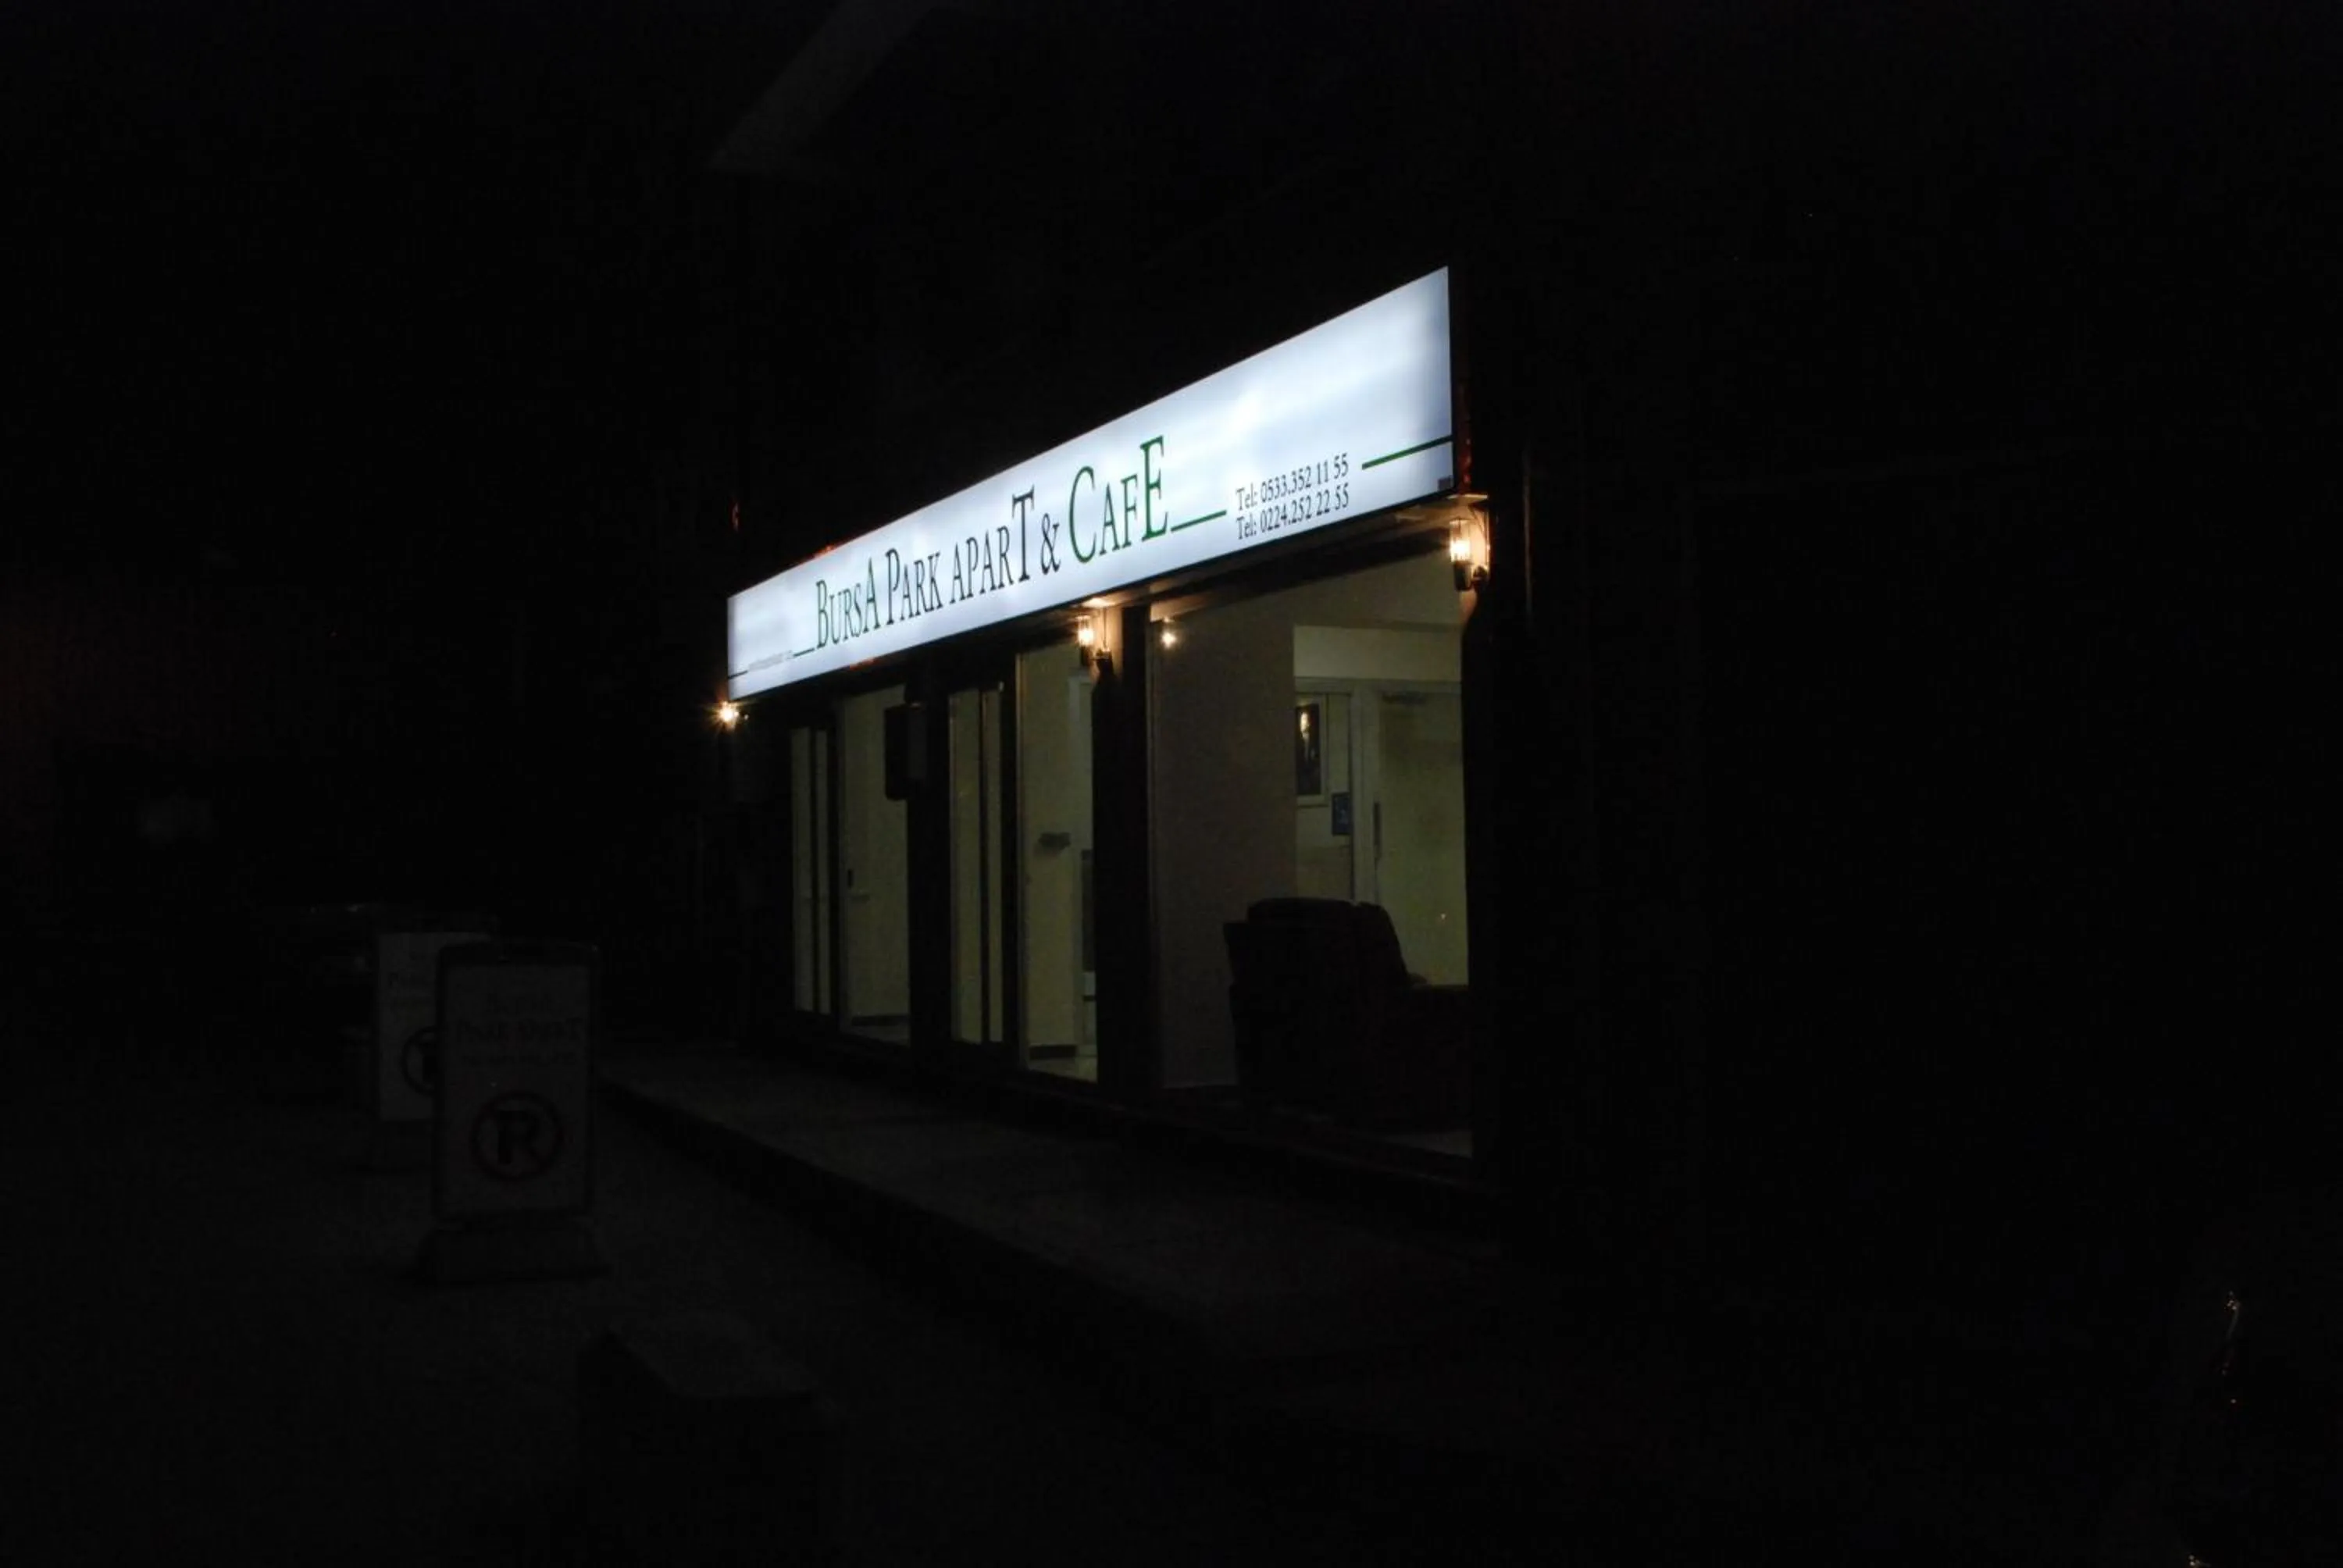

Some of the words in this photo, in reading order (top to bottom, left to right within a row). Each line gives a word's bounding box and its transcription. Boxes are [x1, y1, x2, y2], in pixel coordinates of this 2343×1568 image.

[1236, 482, 1258, 511] Tel:
[1261, 465, 1312, 504] 0533.352
[1317, 459, 1329, 486] 11
[1333, 452, 1350, 479] 55
[1236, 512, 1257, 540] Tel:
[1260, 495, 1312, 533] 0224.252
[1316, 489, 1331, 516] 22
[1335, 482, 1350, 511] 55
[815, 556, 881, 649] BURSA
[885, 547, 943, 625] PARK
[949, 483, 1035, 604] APART
[1040, 512, 1061, 576] &
[1068, 435, 1169, 564] CAFE
